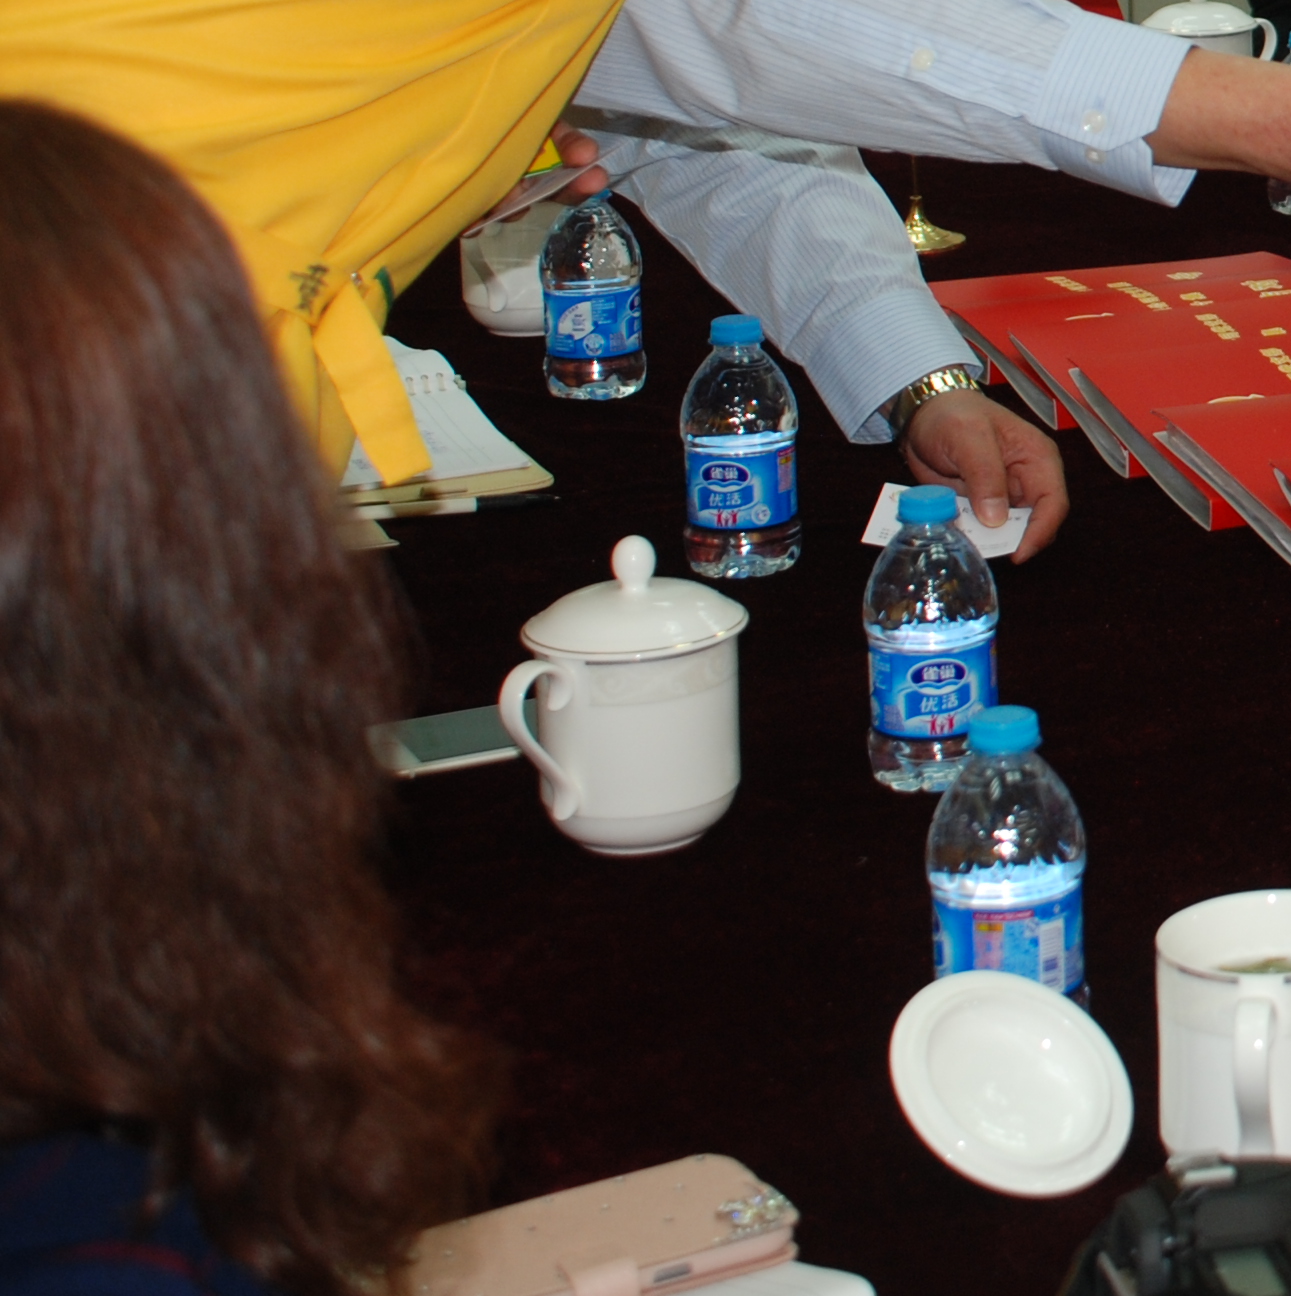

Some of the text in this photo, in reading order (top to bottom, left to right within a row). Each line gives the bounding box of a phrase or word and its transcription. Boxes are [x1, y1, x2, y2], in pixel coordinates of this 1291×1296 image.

[709, 465, 740, 481] 雀巢
[707, 492, 743, 507] 优活
[920, 664, 957, 682] 雀巢
[918, 693, 960, 713] 优活
